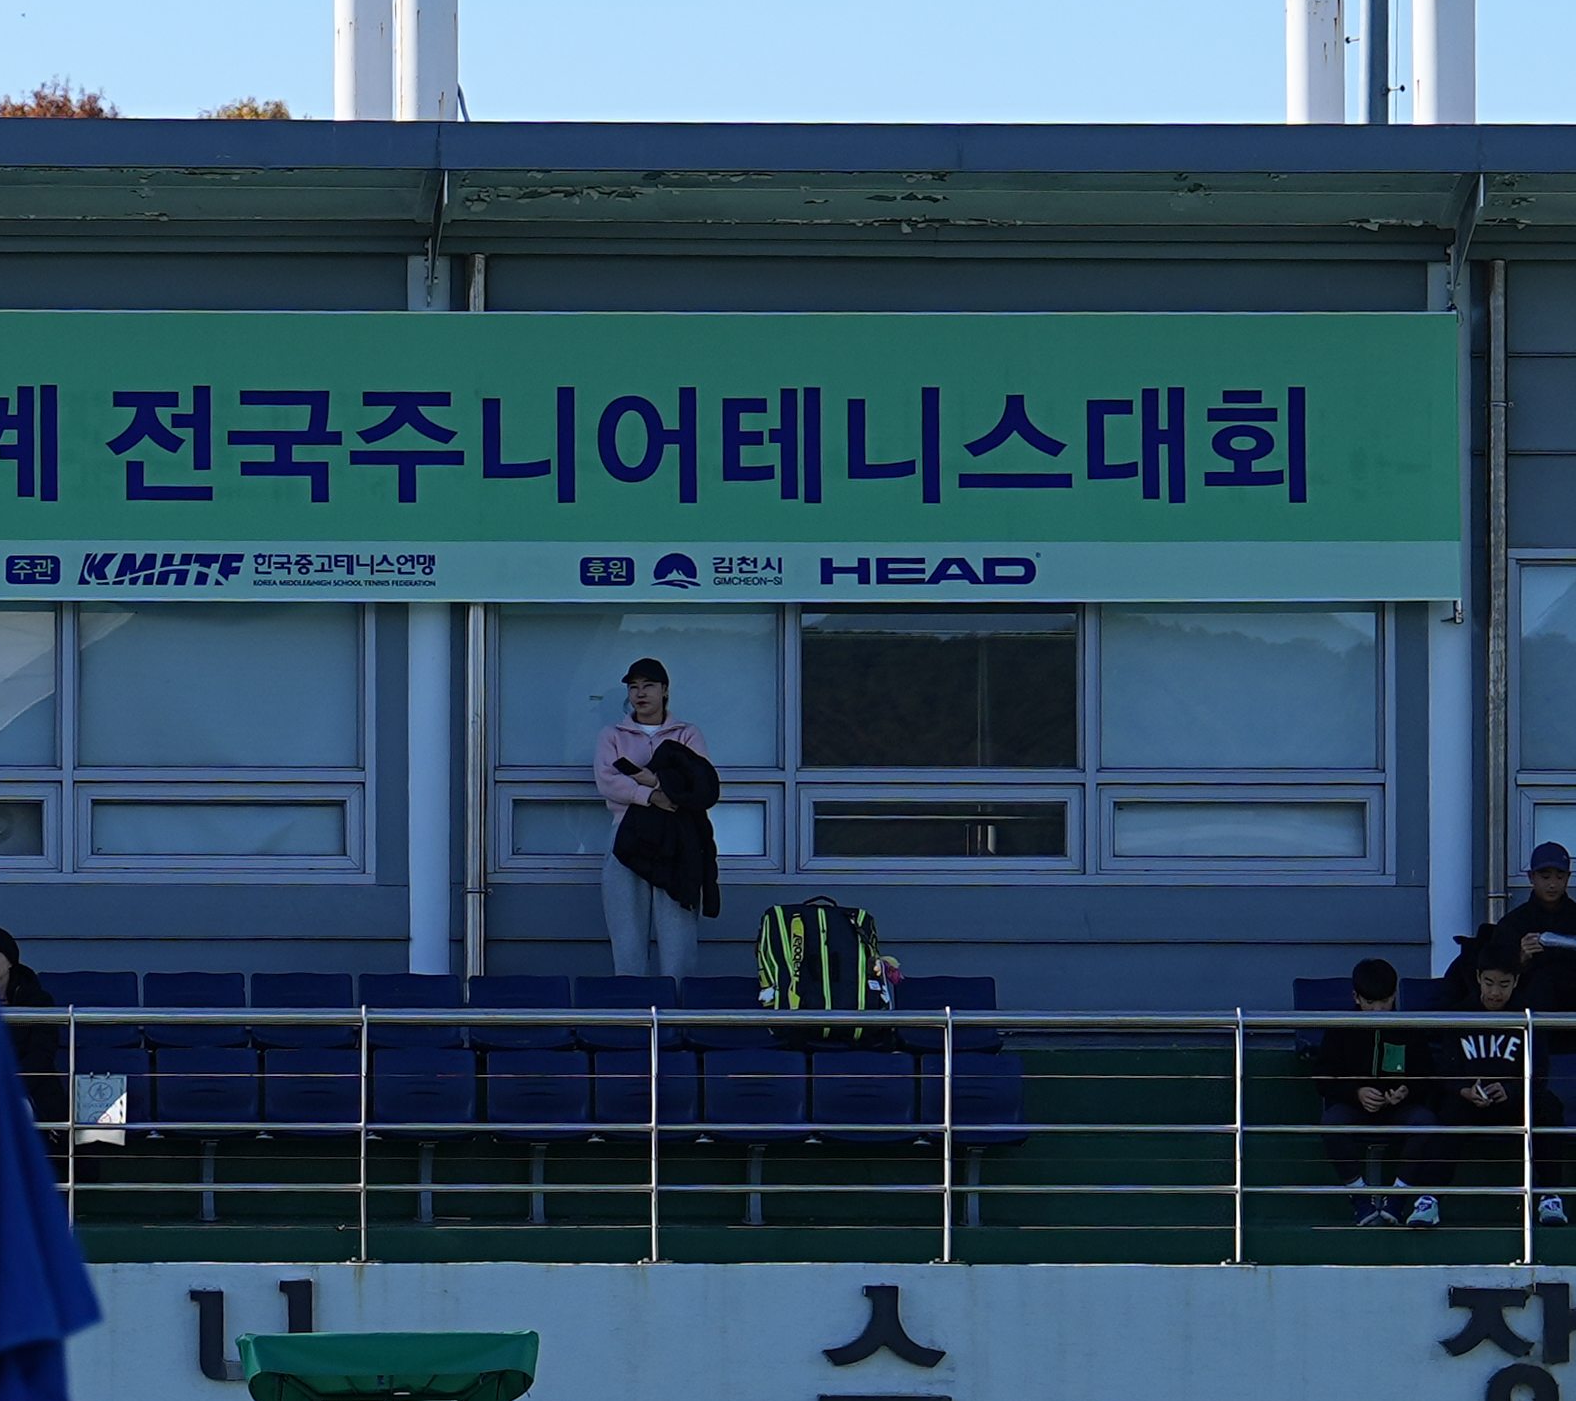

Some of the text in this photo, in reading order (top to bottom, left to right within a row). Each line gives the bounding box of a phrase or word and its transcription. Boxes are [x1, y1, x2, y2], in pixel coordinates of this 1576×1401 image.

[106, 386, 1308, 504] 전국주니어테니스대회
[11, 559, 55, 581] 주관
[78, 553, 247, 587] KMHTF
[253, 553, 437, 576] 한국중고테니스연맹
[585, 560, 630, 582] 후원
[713, 556, 784, 575] 김천시
[820, 557, 1036, 586] HEAD
[333, 580, 363, 588] SCHOOL
[364, 580, 390, 588] TENNIS
[391, 580, 437, 588] FEDERATION
[713, 577, 784, 586] GIMCHEON-SI
[1459, 1033, 1522, 1063] NIKE
